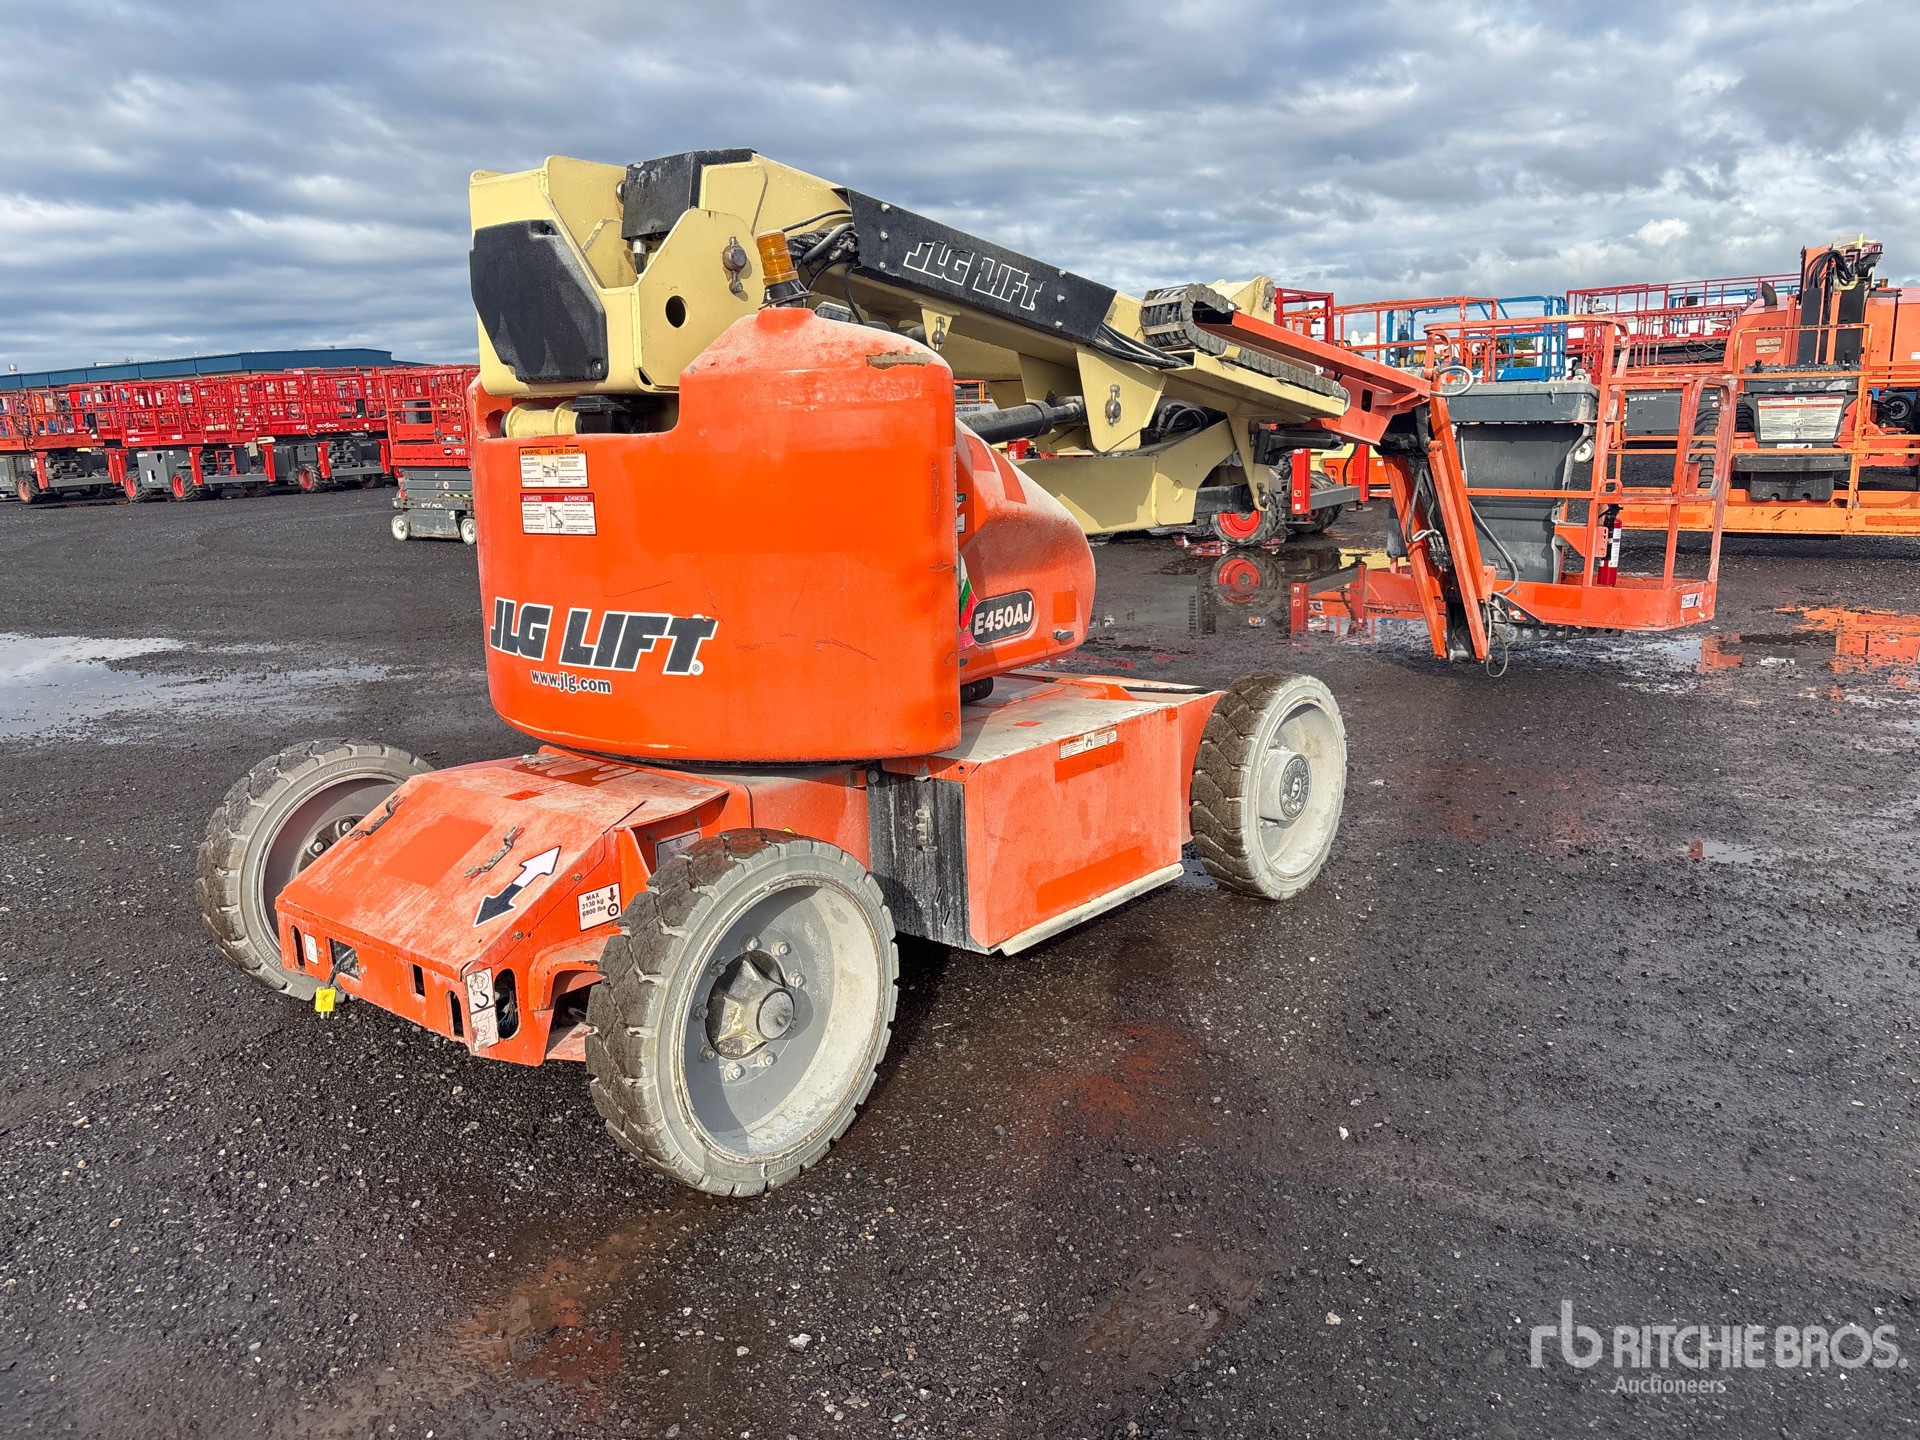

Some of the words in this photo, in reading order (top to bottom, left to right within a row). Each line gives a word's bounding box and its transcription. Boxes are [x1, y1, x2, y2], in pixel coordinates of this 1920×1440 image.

[903, 240, 975, 286] JLG
[972, 257, 1046, 311] LIFT
[974, 600, 1033, 636] E450AJ
[490, 596, 553, 661] JLG
[558, 607, 719, 674] LIFT
[531, 669, 612, 694] www.jlg.com
[582, 900, 596, 910] 3130
[596, 899, 605, 907] kg
[586, 892, 600, 901] MAX
[582, 908, 596, 917] 6900
[597, 905, 606, 913] lbs
